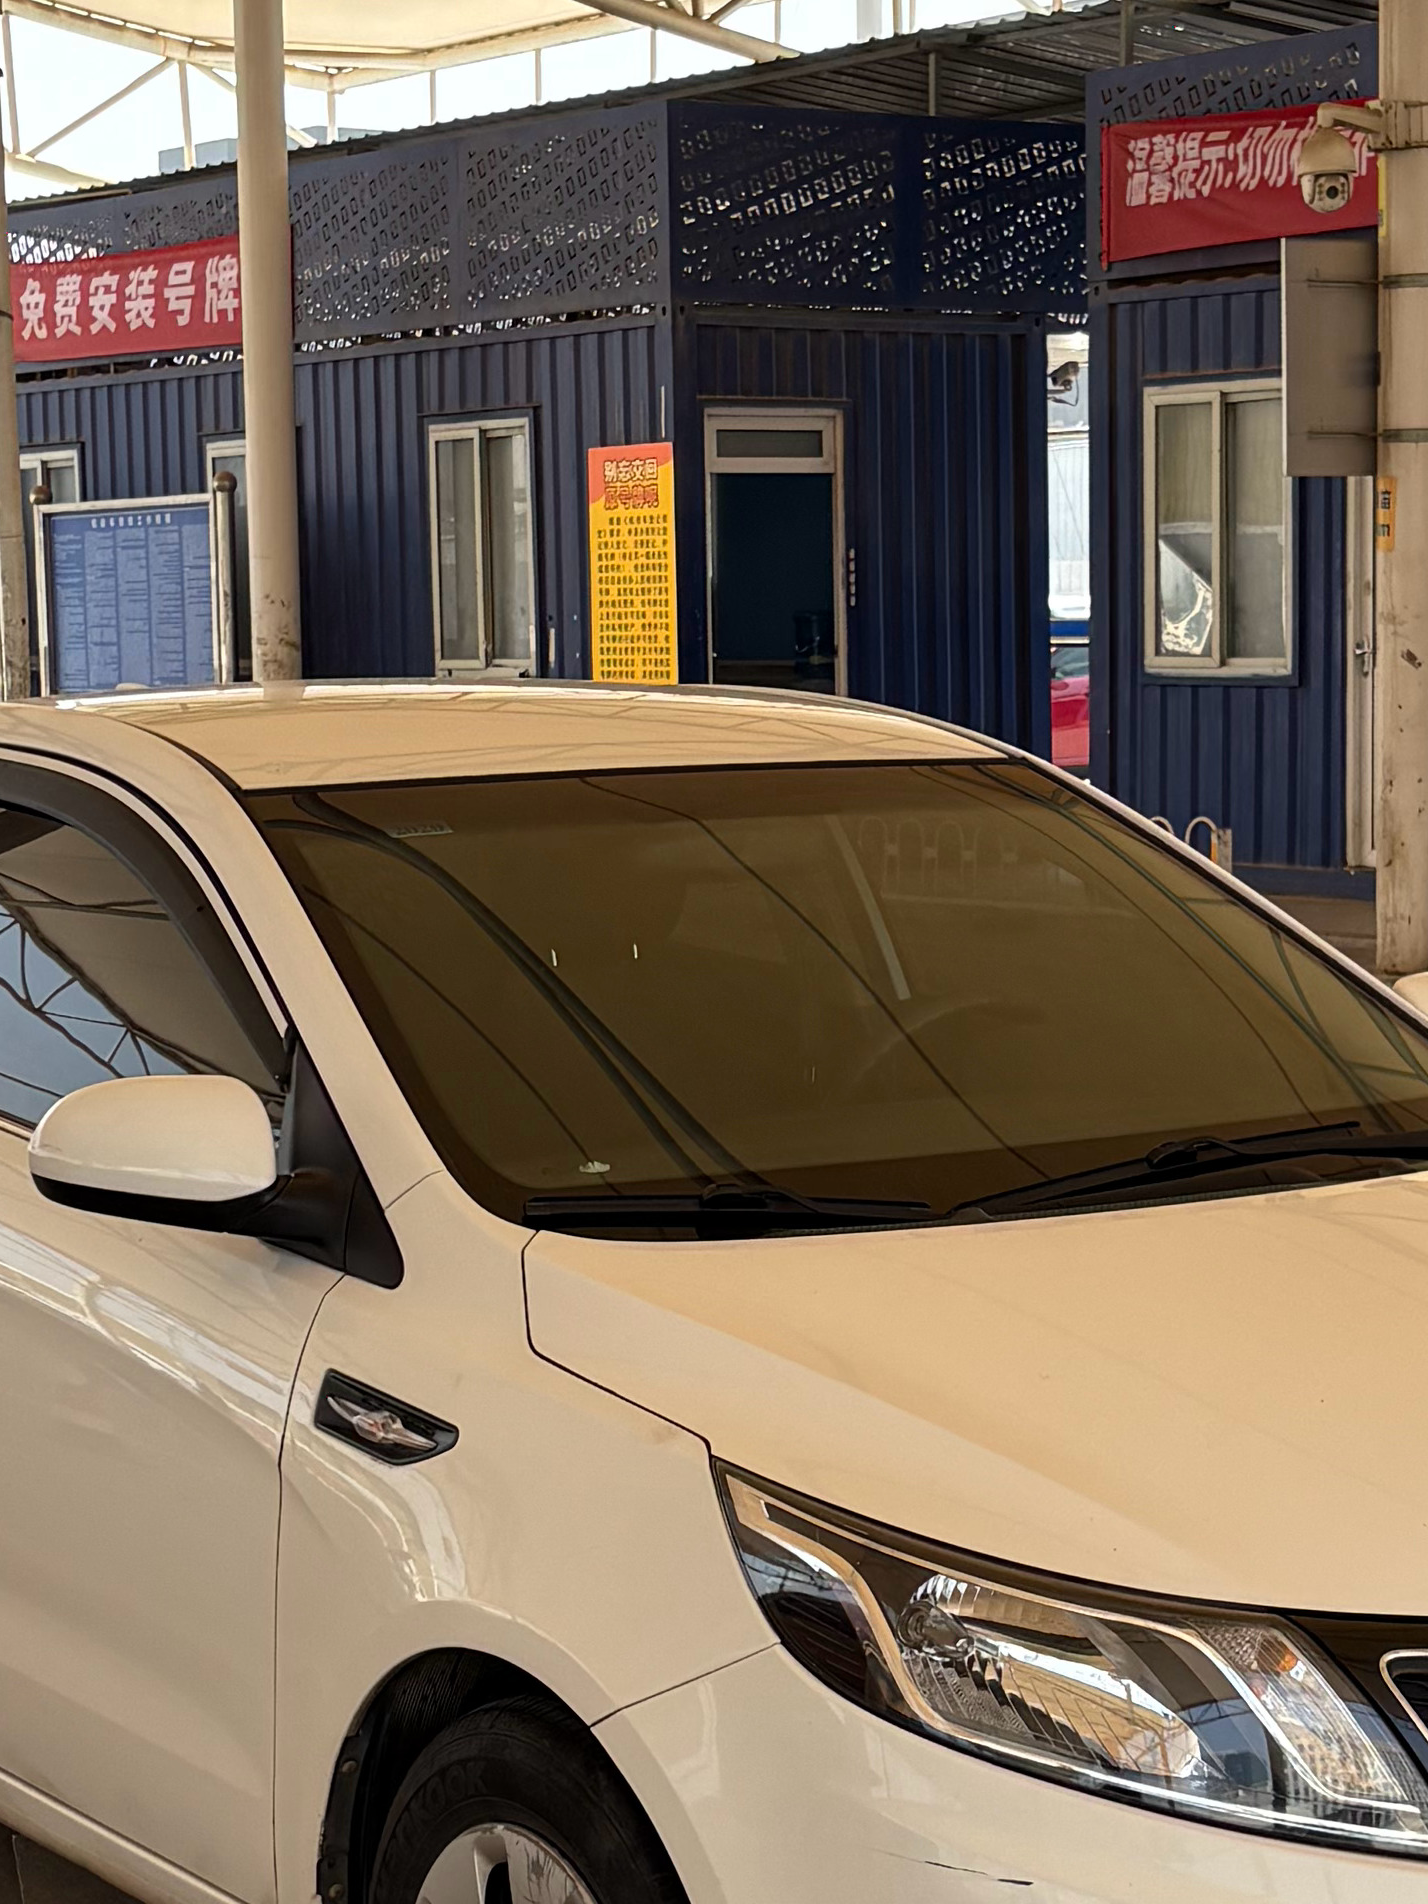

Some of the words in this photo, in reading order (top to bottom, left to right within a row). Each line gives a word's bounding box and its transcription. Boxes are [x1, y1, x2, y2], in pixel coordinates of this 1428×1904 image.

[19, 253, 240, 341] 免费安装号牌
